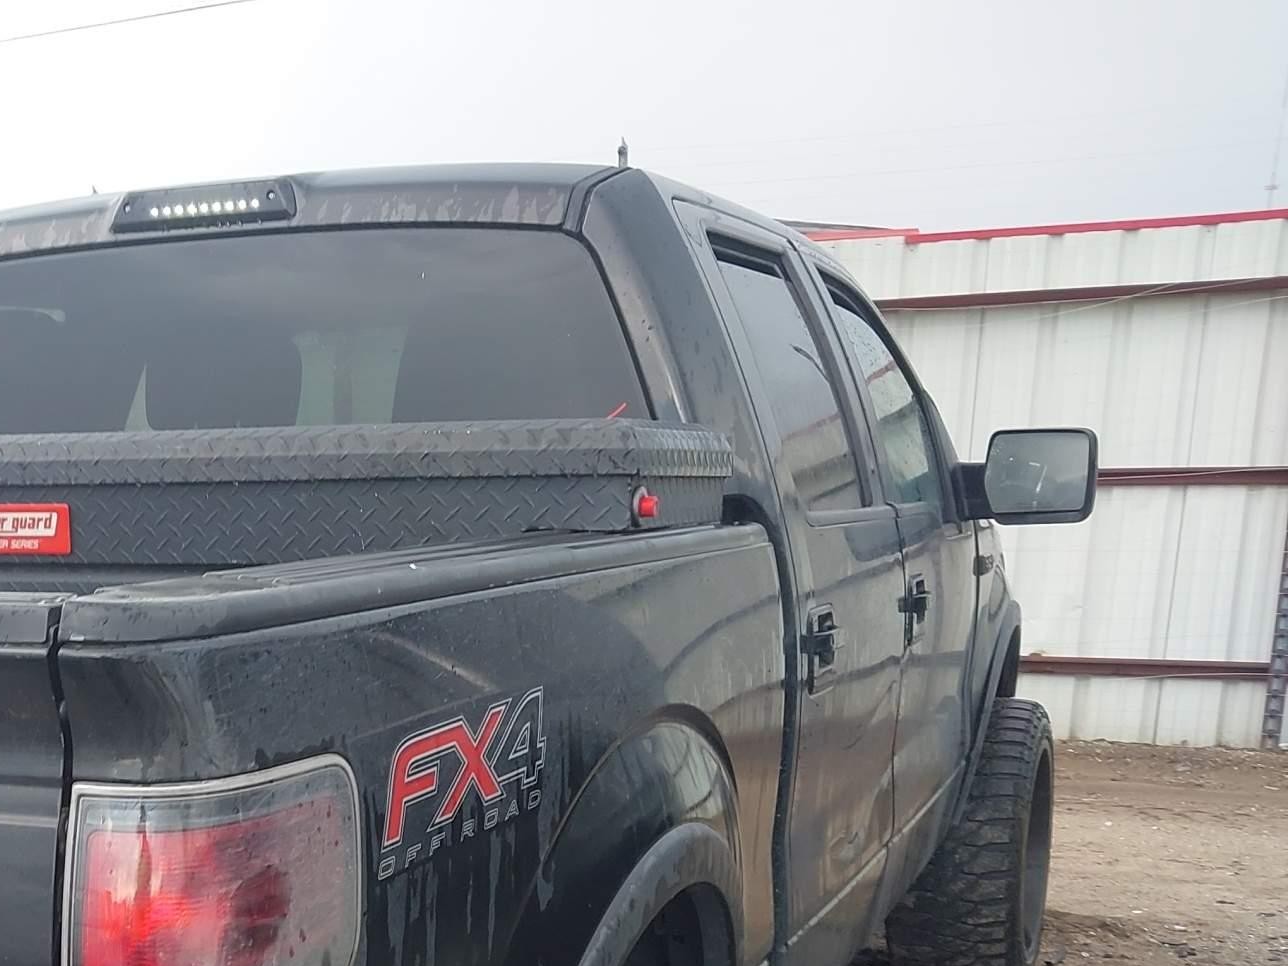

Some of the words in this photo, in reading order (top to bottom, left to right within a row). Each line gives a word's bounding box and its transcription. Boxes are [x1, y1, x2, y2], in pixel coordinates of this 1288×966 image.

[11, 538, 40, 549] SERIES
[12, 512, 53, 533] guard
[381, 686, 547, 854] FX4
[377, 831, 446, 881] OFF
[460, 789, 542, 843] ROAD
